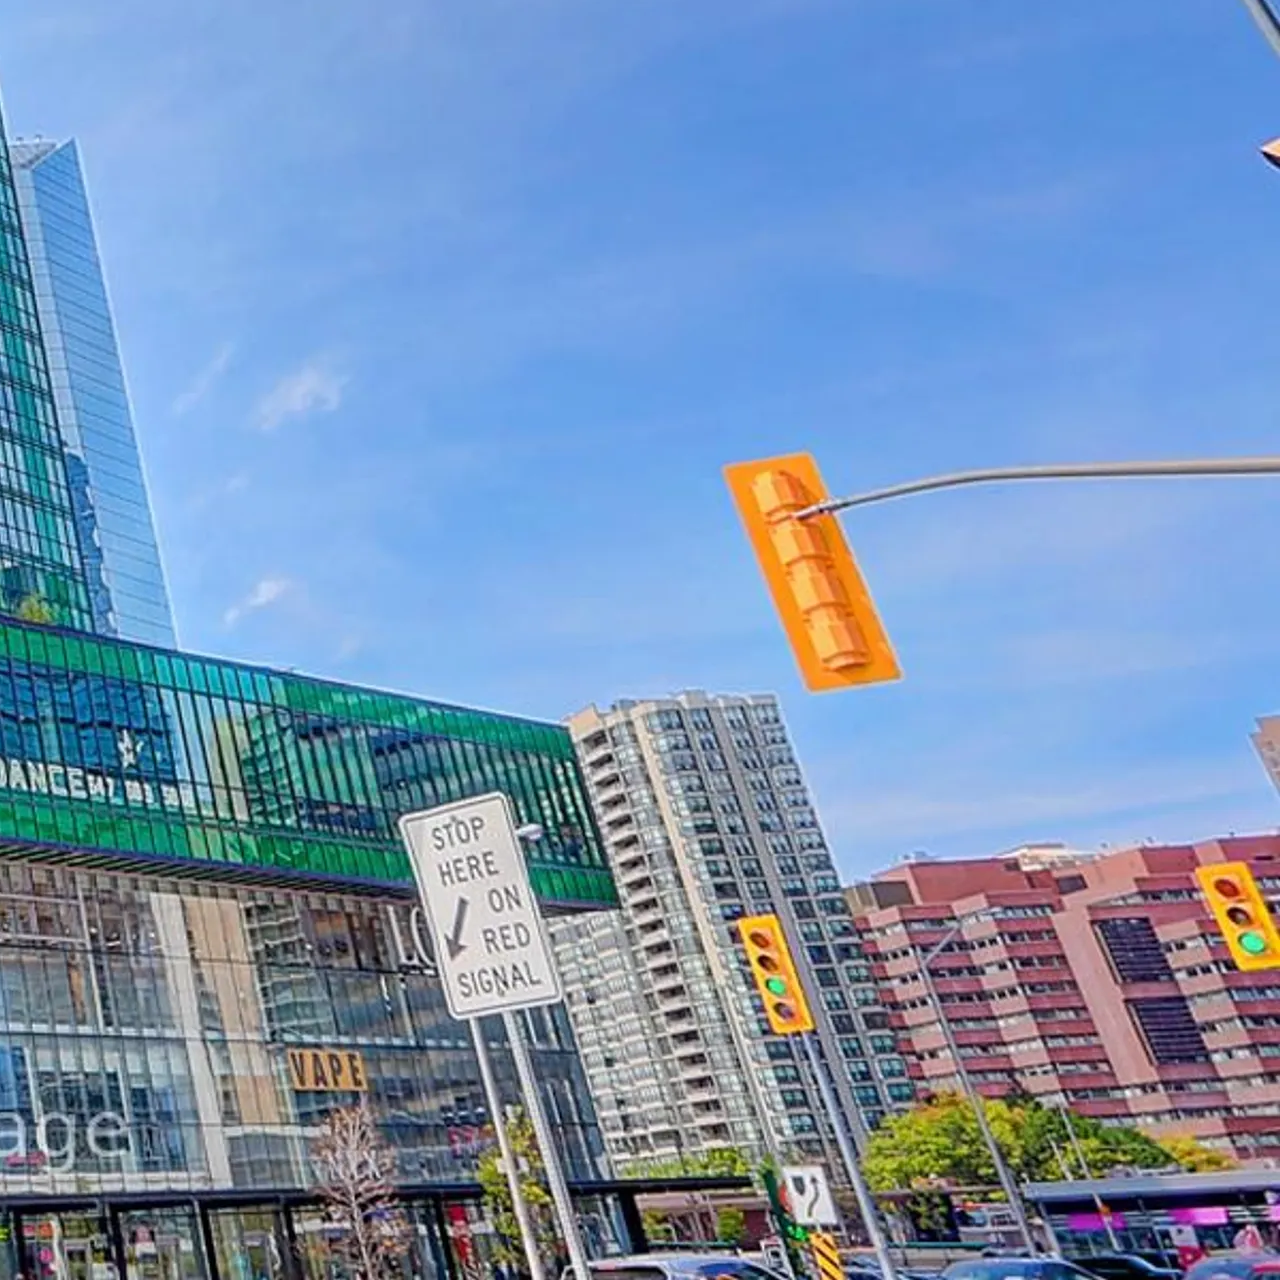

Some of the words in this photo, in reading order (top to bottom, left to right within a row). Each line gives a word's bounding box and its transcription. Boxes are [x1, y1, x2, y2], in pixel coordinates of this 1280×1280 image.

[432, 816, 485, 851] STOP
[438, 851, 500, 887] HERE
[488, 884, 522, 914] ON
[482, 922, 531, 954] RED
[457, 961, 542, 998] SIGNAL
[290, 1051, 363, 1087] VAPE
